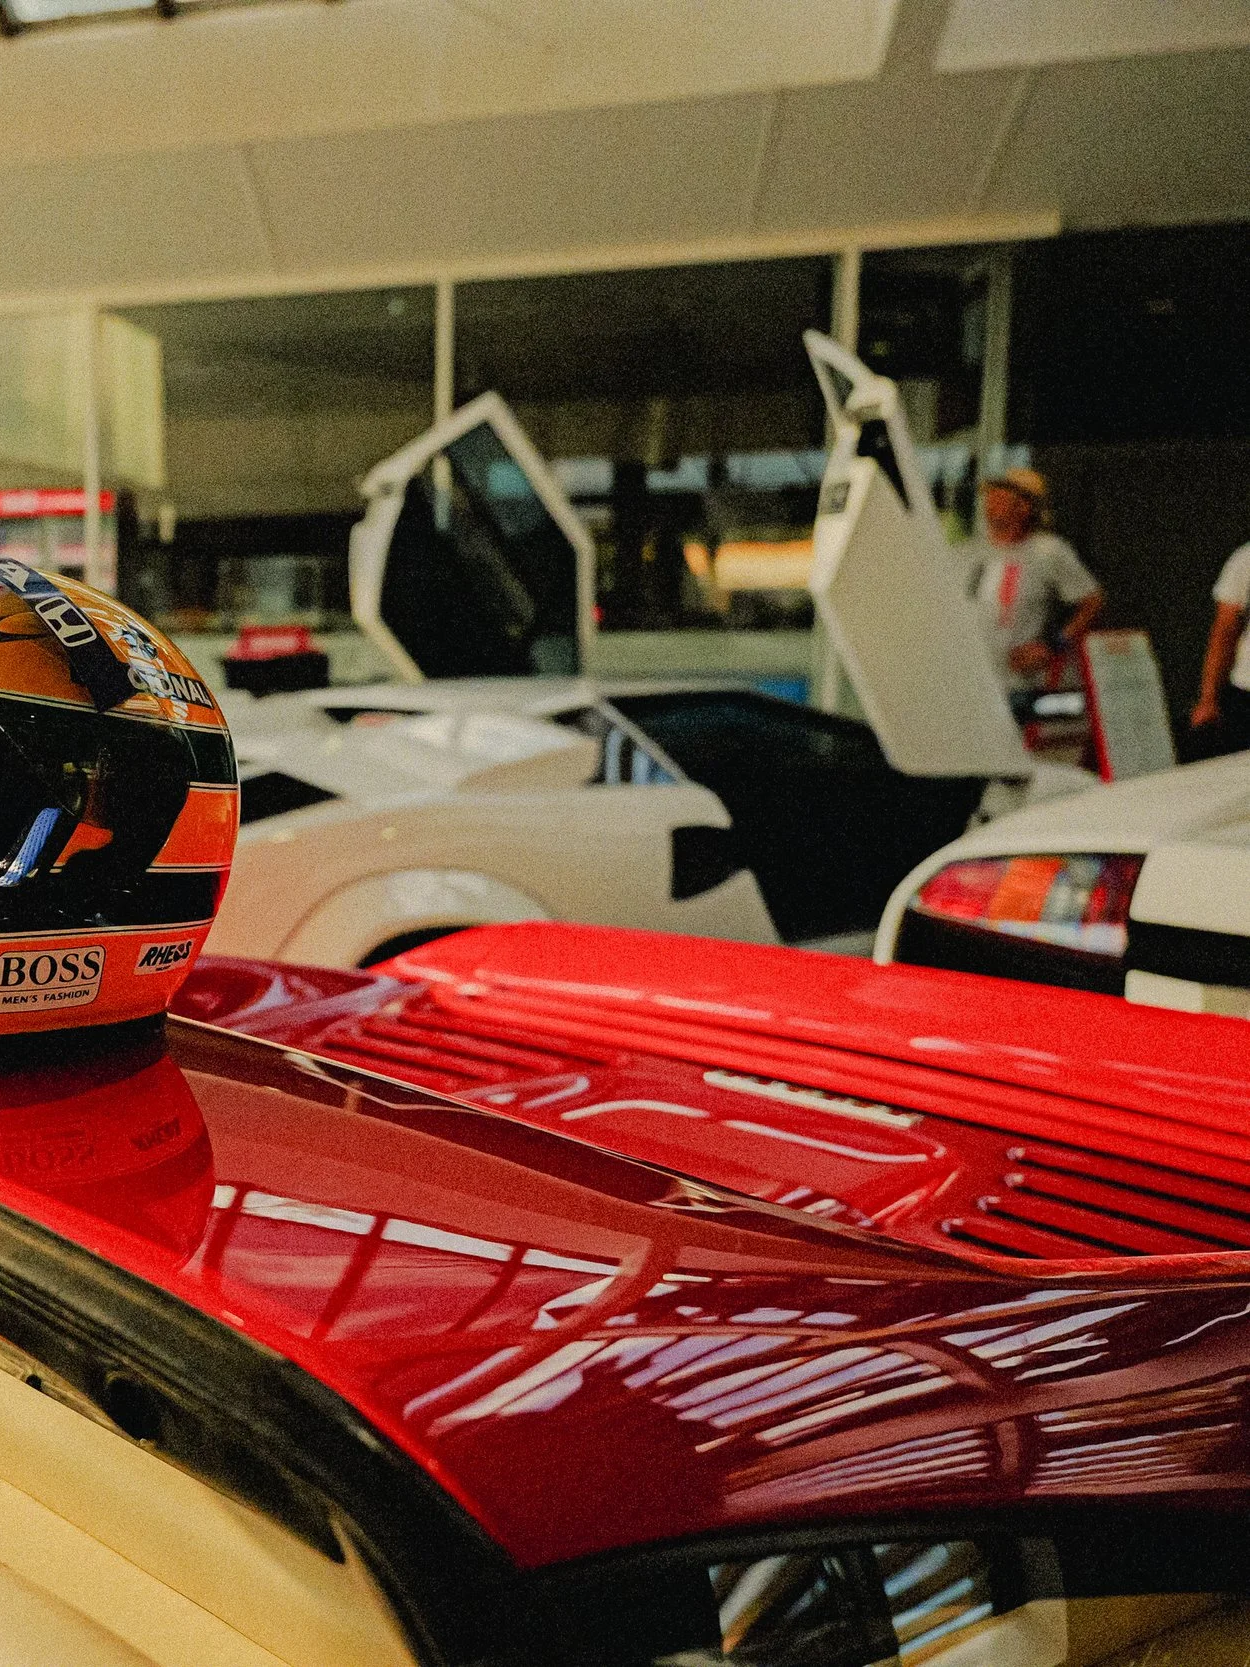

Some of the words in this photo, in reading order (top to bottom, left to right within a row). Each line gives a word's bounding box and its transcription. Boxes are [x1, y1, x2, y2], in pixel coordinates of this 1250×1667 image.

[0, 951, 100, 987] BOSS
[1, 995, 38, 1005] MEN'S
[43, 989, 90, 1001] FASHION
